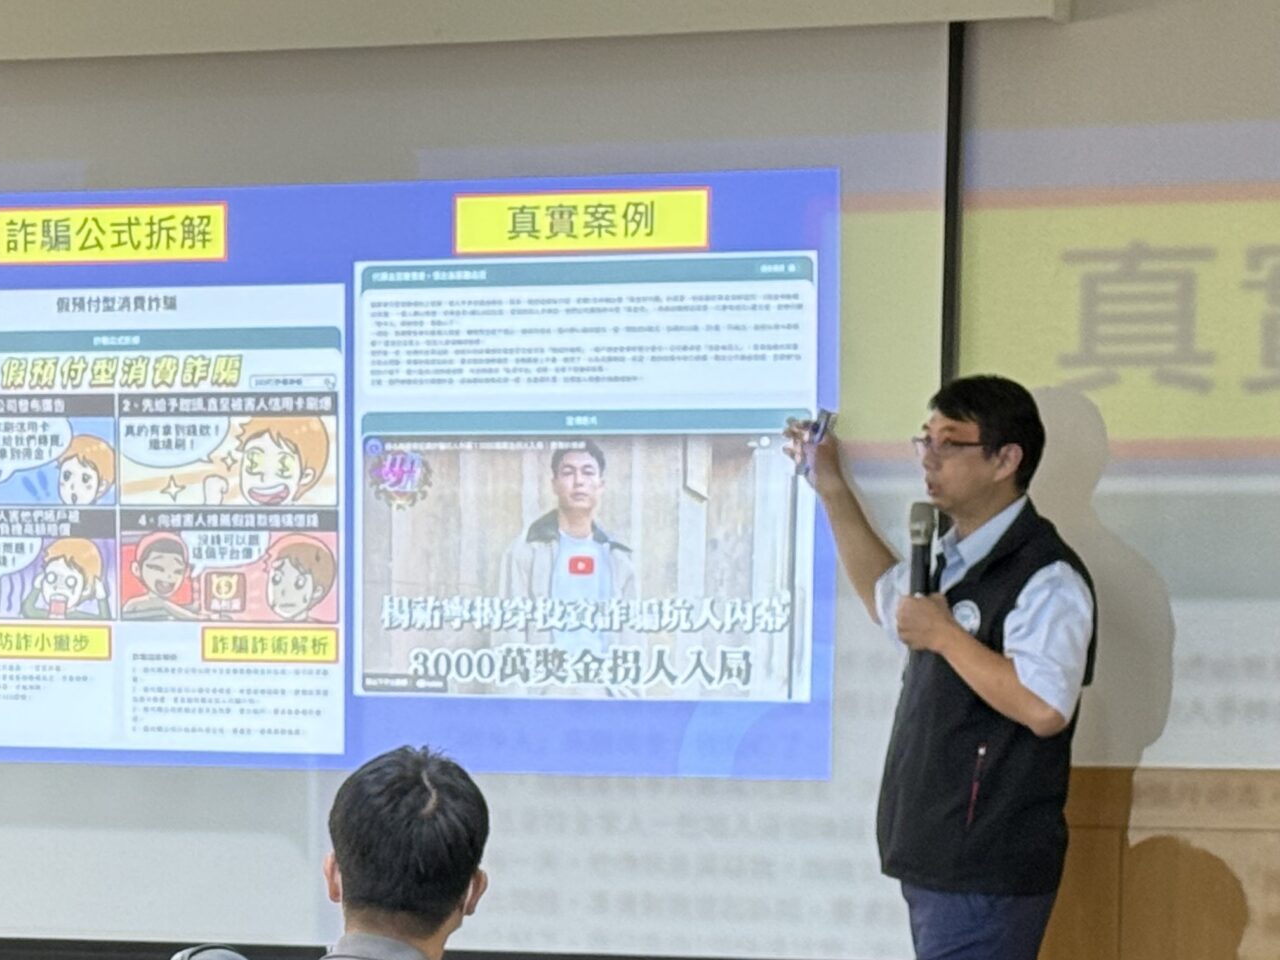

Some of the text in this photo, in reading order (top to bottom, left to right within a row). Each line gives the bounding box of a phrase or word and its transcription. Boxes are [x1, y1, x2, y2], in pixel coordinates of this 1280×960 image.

[6, 215, 213, 254] 詐騙公式拆解
[507, 200, 655, 240] 真實案例
[56, 294, 177, 314] 假預付型消費詐騙
[0, 353, 242, 389] 假預付型消費詐騙
[410, 647, 753, 687] 3000萬獎金拐人入局
